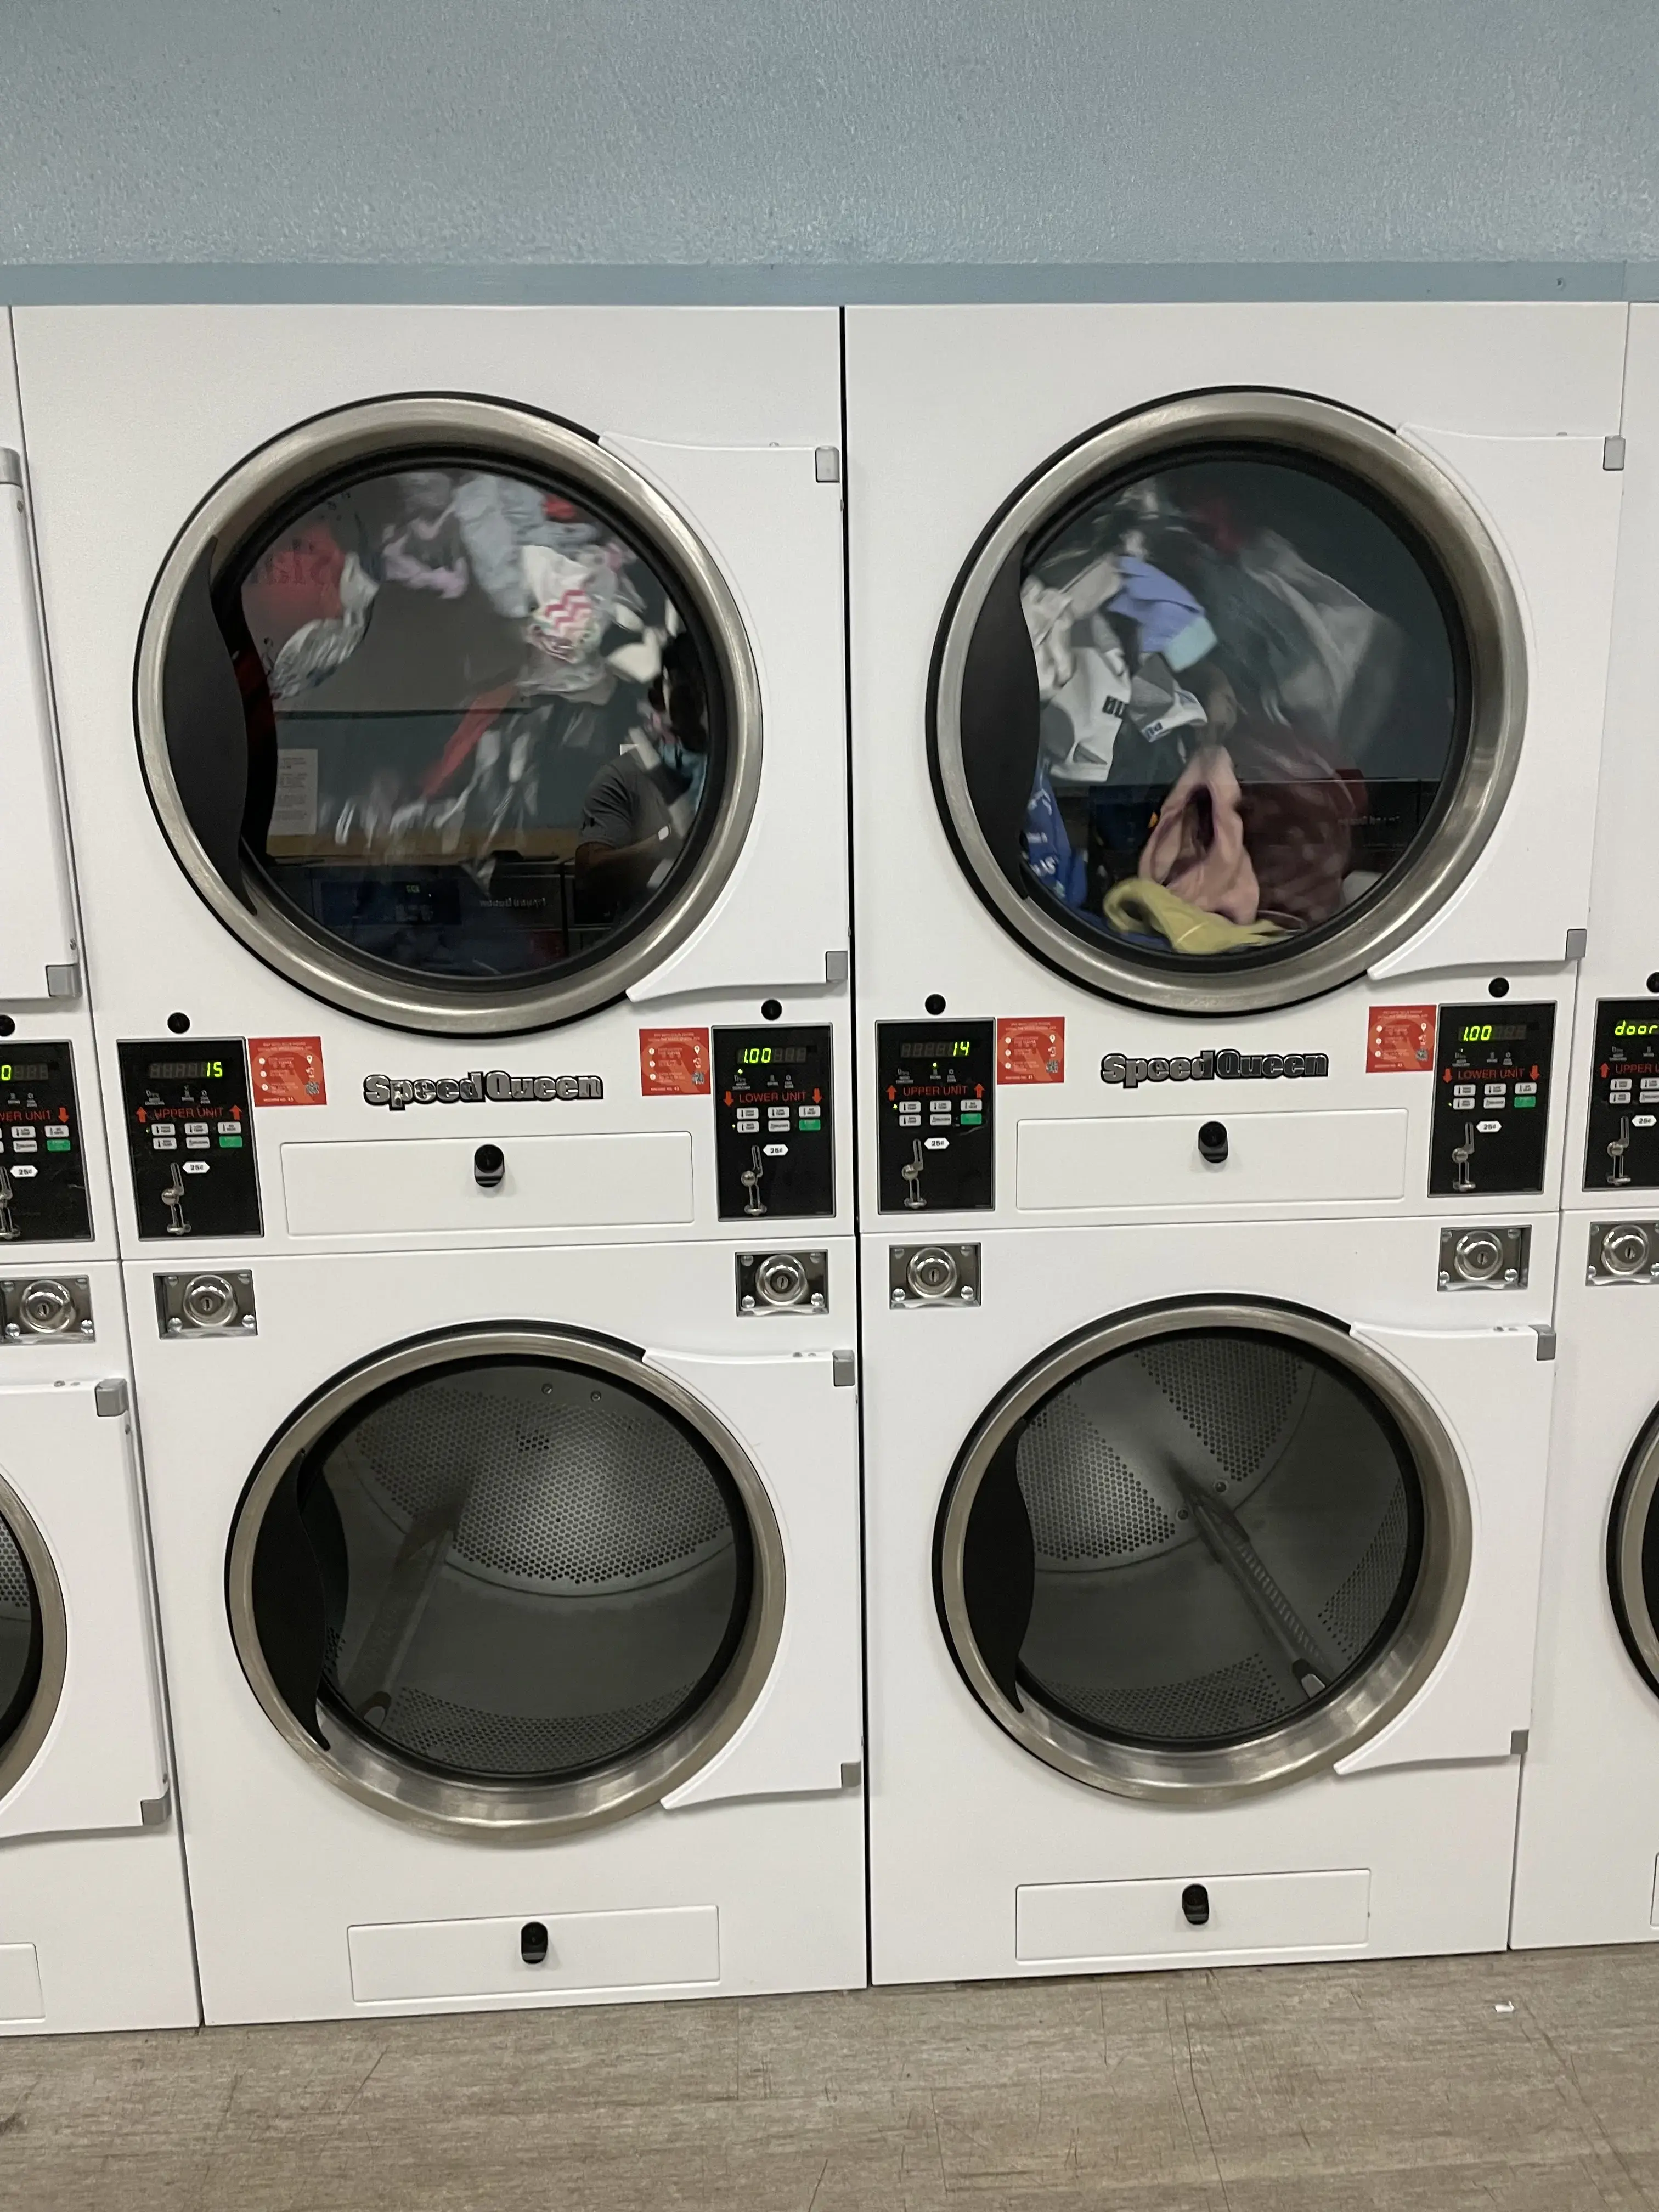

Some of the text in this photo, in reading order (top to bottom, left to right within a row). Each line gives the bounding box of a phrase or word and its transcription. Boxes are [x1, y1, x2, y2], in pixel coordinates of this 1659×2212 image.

[1463, 1025, 1492, 1041] 1.00
[1615, 1020, 1658, 1036] door
[953, 1041, 970, 1056] 14
[743, 1048, 771, 1063] 1.00
[207, 1062, 223, 1077] 15
[1458, 1069, 1525, 1080] LOWER UNIT
[1615, 1064, 1652, 1074] UPPER
[903, 1085, 968, 1096] UPPER UNIT
[739, 1092, 806, 1103] LOWER UNIT
[25, 1110, 51, 1121] UNIT
[154, 1107, 224, 1120] UPPER UNIT
